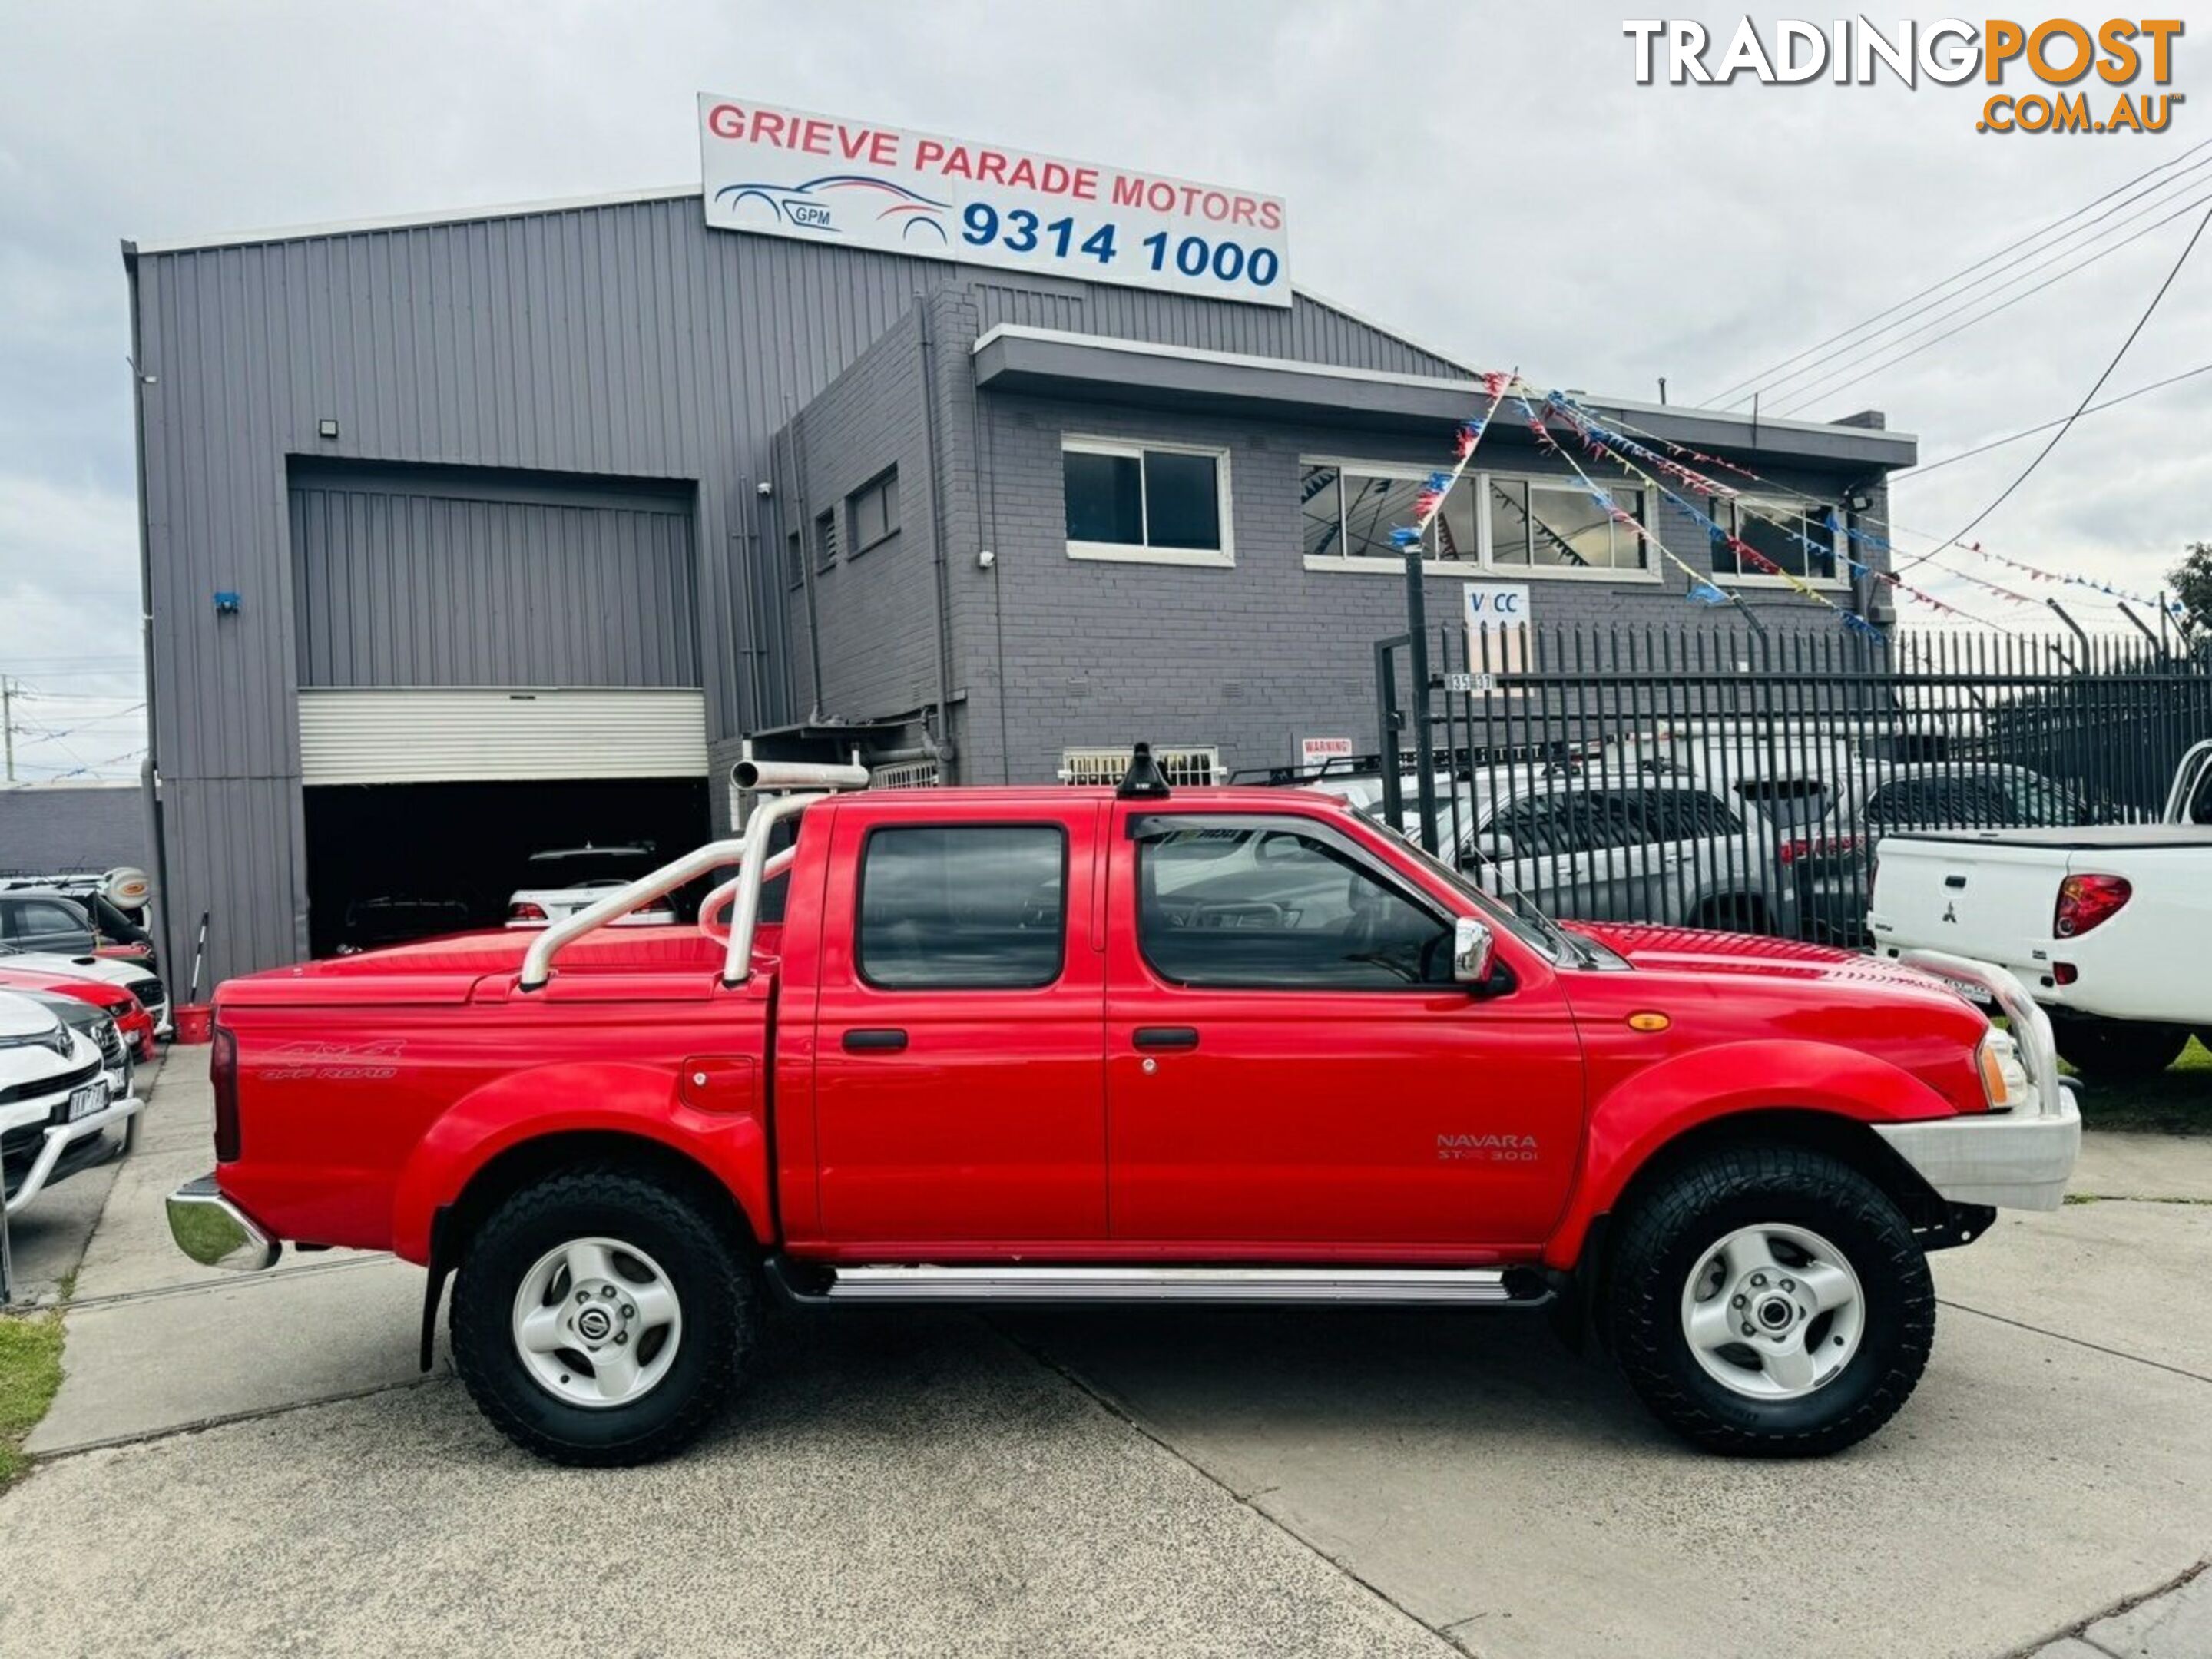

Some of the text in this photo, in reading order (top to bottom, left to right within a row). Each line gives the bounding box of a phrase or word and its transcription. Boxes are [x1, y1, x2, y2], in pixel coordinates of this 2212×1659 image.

[708, 104, 1281, 230] GRIEVE PARADE MOTORS
[796, 207, 830, 224] GPM
[962, 202, 1278, 286] 9314 1000
[317, 1068, 397, 1079] ROAD
[1437, 1134, 1538, 1147] NAVARA
